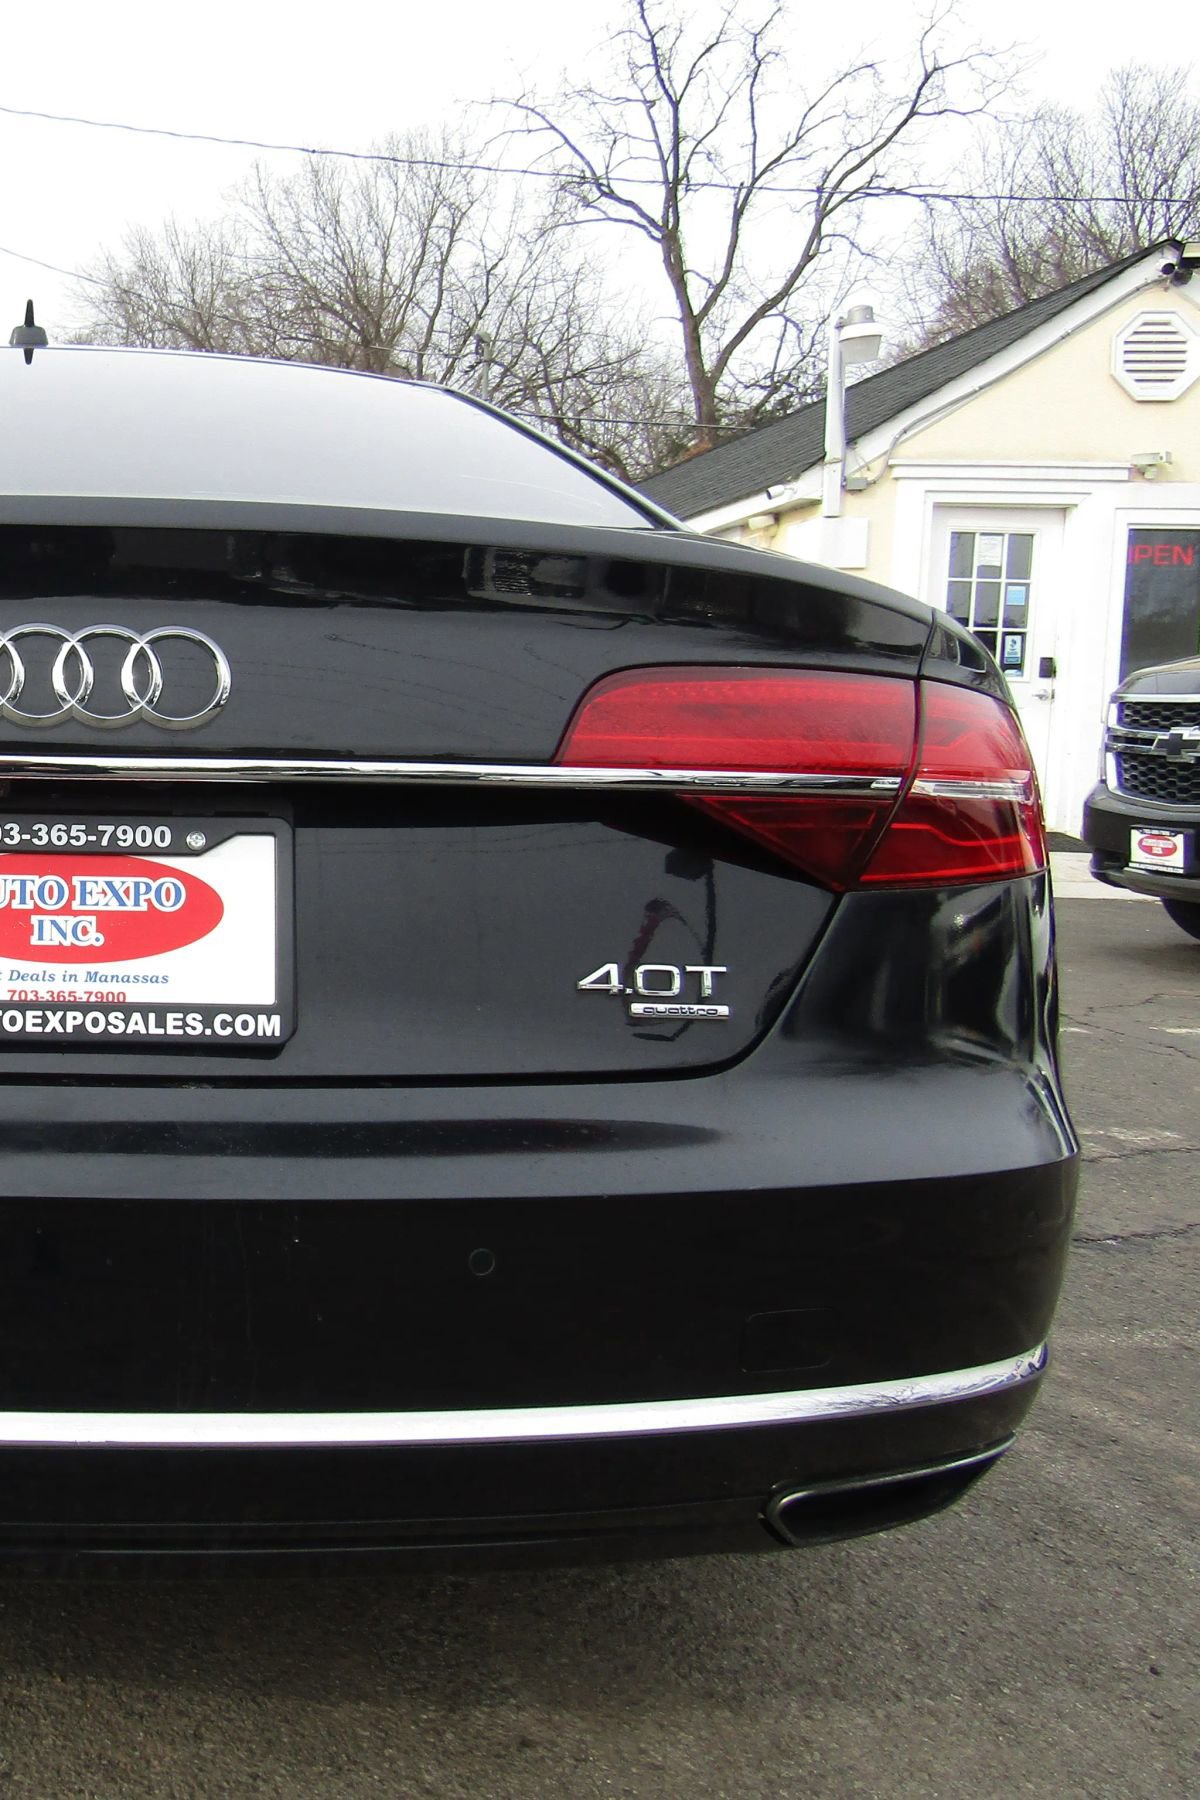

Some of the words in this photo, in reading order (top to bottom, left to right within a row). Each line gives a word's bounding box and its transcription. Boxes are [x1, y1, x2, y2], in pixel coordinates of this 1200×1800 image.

[1128, 543, 1195, 567] PEN
[74, 877, 185, 910] EXPO
[32, 916, 103, 945] INC.
[7, 969, 56, 982] Deals
[62, 970, 79, 983] in
[84, 971, 170, 984] Manassas
[577, 963, 728, 997] 4.0T
[7, 989, 127, 1004] 703-365-7900
[642, 1005, 719, 1017] quattro
